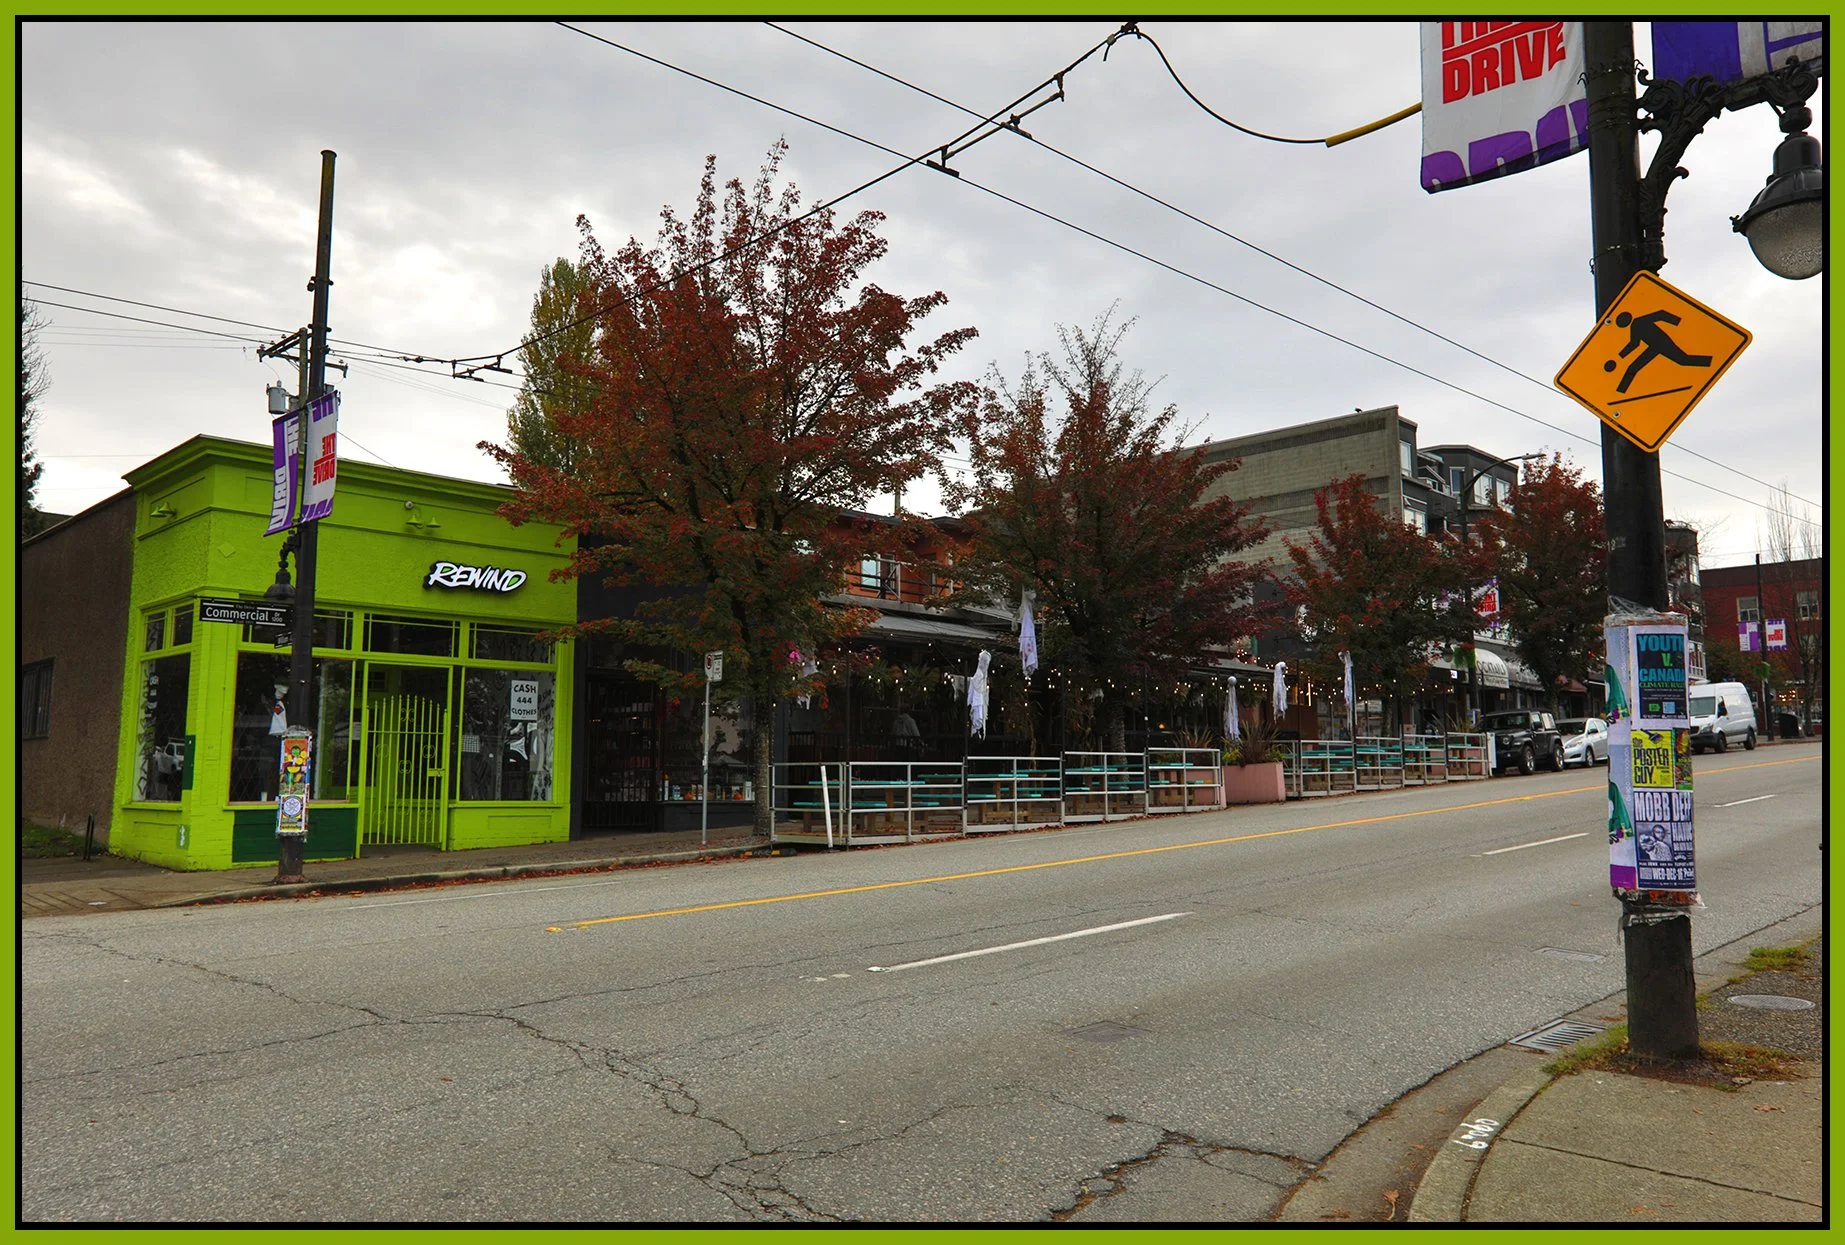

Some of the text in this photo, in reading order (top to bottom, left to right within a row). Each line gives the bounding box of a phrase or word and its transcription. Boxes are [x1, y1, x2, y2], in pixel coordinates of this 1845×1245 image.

[1442, 22, 1567, 104] DRIVE
[429, 562, 527, 592] REWIND
[205, 607, 269, 621] Commercial
[1639, 668, 1685, 682] CANAD
[513, 684, 537, 694] CASH
[512, 708, 537, 716] CLOTHES
[1633, 748, 1669, 766] POSTER
[1634, 792, 1670, 821] MOBB
